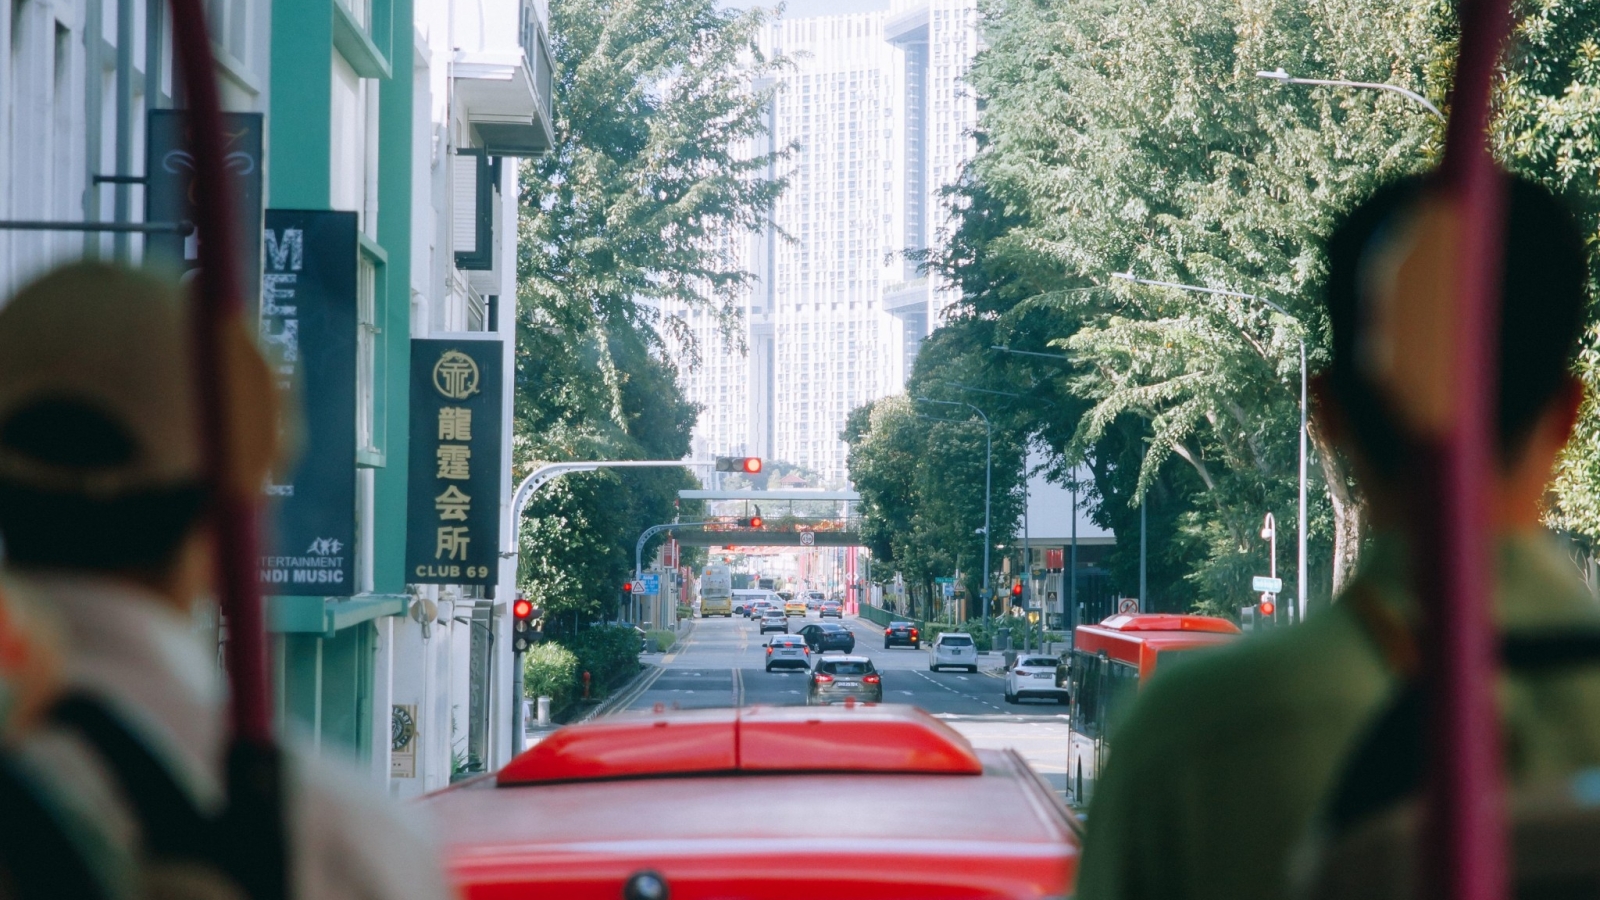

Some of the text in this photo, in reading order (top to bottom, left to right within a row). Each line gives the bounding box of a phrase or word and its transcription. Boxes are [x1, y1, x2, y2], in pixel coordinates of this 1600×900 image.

[436, 406, 472, 560] 龍霆会所
[293, 569, 344, 582] MUSIC
[415, 565, 488, 578] CLUB 69
[392, 706, 412, 724] EART
